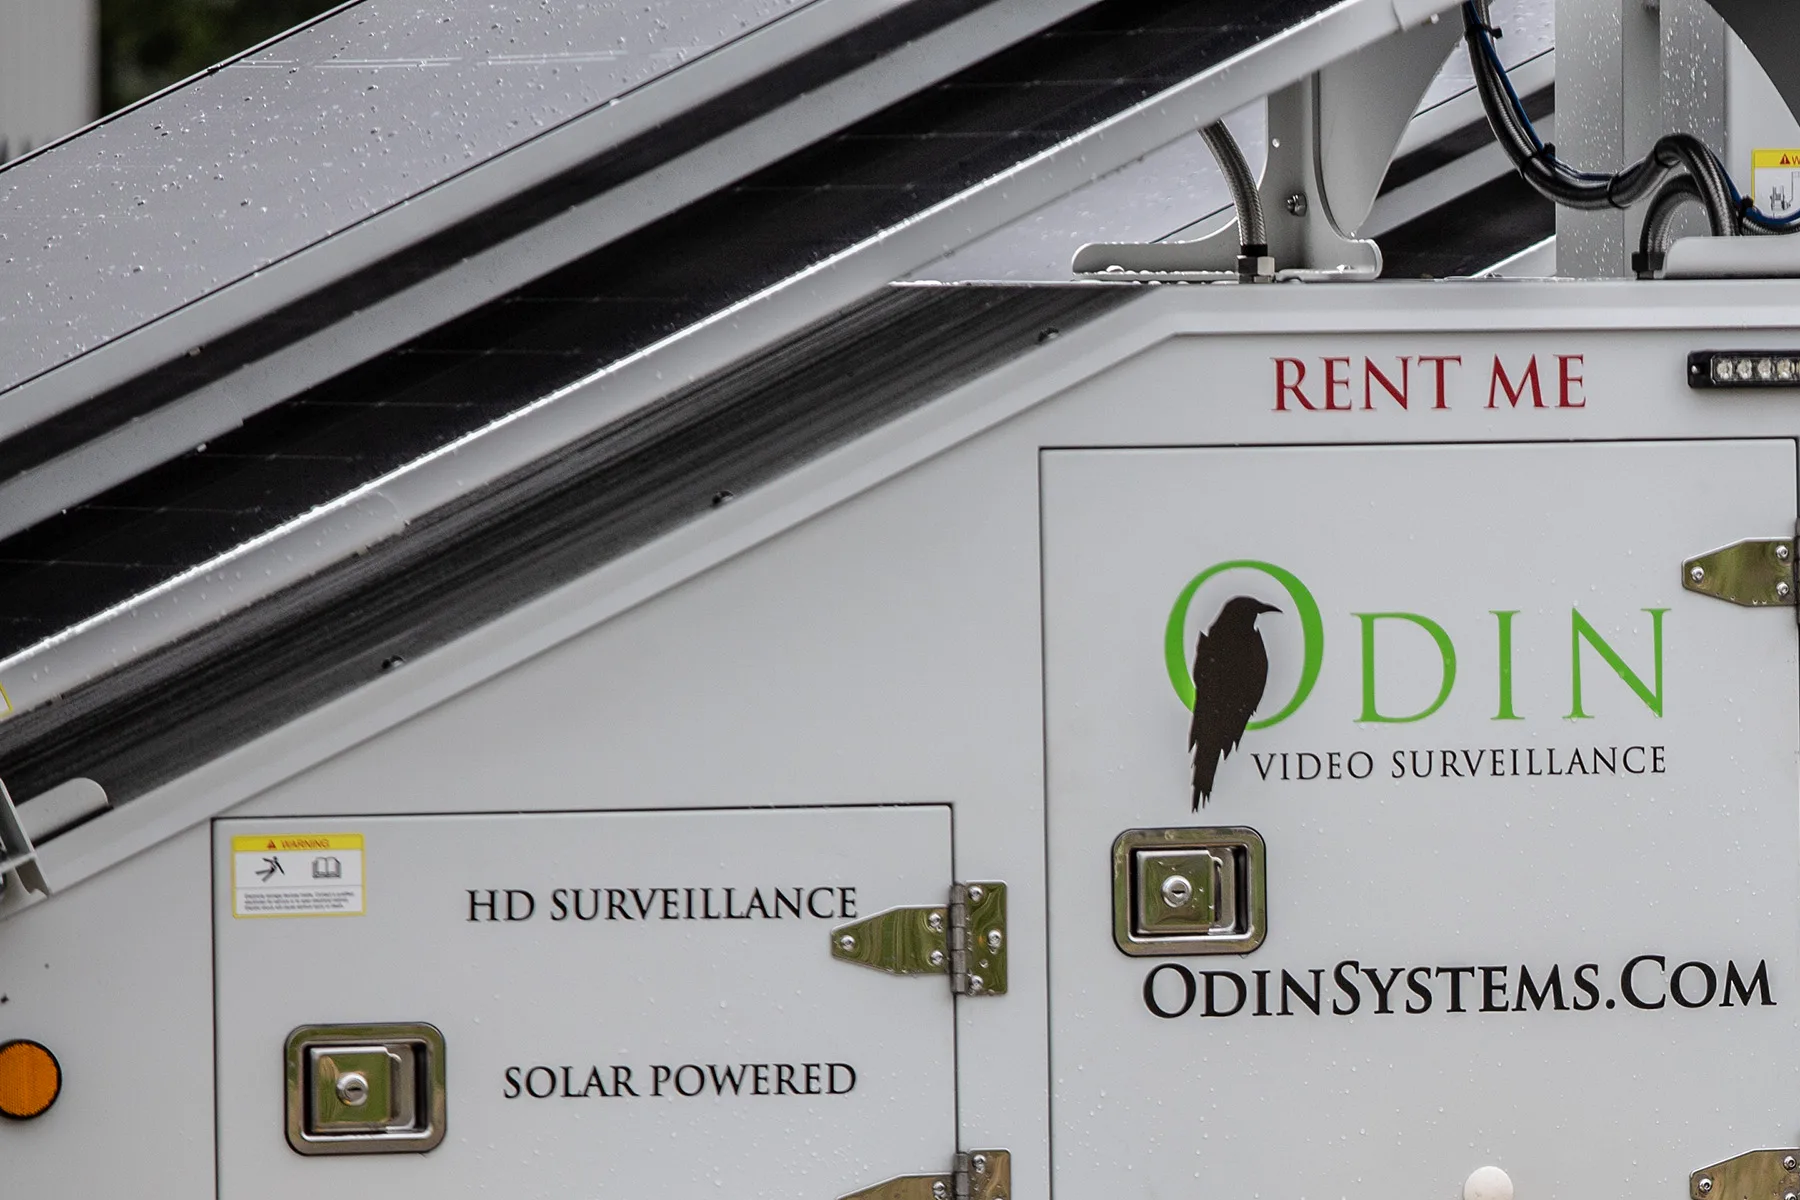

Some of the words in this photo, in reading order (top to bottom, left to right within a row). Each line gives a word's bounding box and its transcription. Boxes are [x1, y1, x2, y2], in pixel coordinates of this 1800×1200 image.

[1272, 355, 1463, 412] RENT
[1485, 353, 1586, 409] ME
[1252, 750, 1374, 782] VIDEO
[1391, 745, 1667, 779] SURVEILLANCE
[281, 838, 329, 849] WARNING
[465, 888, 537, 923] HD
[550, 885, 859, 922] SURVEILLANCE
[503, 1065, 634, 1100] SOLAR
[650, 1062, 858, 1097] POWERED
